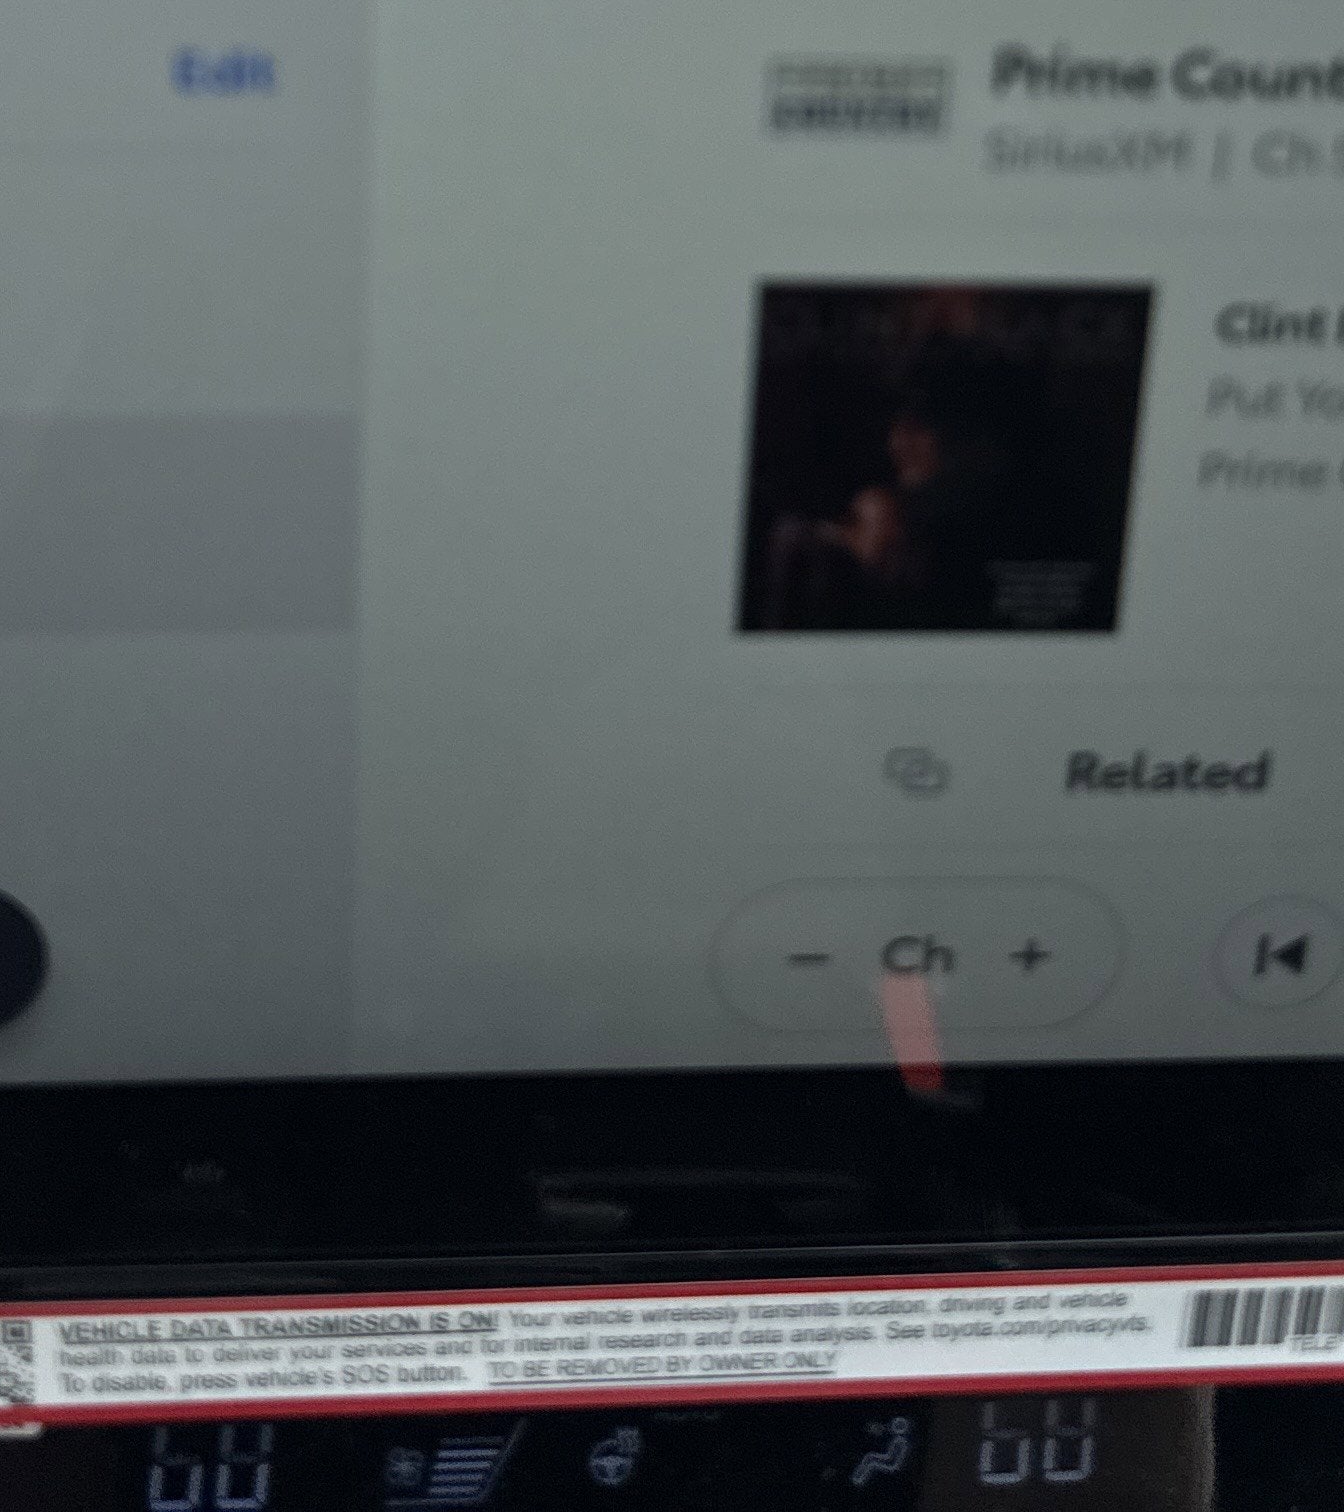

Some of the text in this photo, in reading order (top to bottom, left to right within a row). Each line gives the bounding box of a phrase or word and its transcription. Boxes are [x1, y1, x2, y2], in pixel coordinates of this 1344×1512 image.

[173, 47, 277, 95] Edit
[990, 46, 1158, 100] Prime
[1252, 132, 1316, 178] Ch
[1215, 303, 1323, 348] Clint
[1206, 380, 1285, 423] Put
[1199, 452, 1327, 494] Prime
[1064, 748, 1272, 796] Related
[881, 934, 955, 976] Ch
[60, 1320, 162, 1339] VEHICLE
[170, 1317, 234, 1337] DATA
[240, 1312, 420, 1335] TRANSMISSION
[430, 1311, 450, 1330] IS
[511, 1309, 553, 1327] Your
[563, 1306, 633, 1326] vehicle
[1013, 1292, 1050, 1311] and
[1059, 1290, 1128, 1309] vehicle
[60, 1346, 123, 1366] health
[131, 1344, 177, 1364] data
[185, 1343, 205, 1362] to
[213, 1341, 279, 1362] deliver
[289, 1342, 334, 1364] your
[342, 1341, 427, 1358] services
[435, 1337, 473, 1355] and
[599, 1329, 687, 1350] research
[694, 1327, 733, 1346] and
[740, 1325, 784, 1344] data
[886, 1320, 926, 1339] See
[179, 1372, 238, 1392] press
[342, 1363, 391, 1384] SOS
[556, 1356, 659, 1376] REMOVED
[665, 1355, 692, 1372] BY
[699, 1353, 777, 1372] OWNER
[784, 1351, 836, 1369] ONLY
